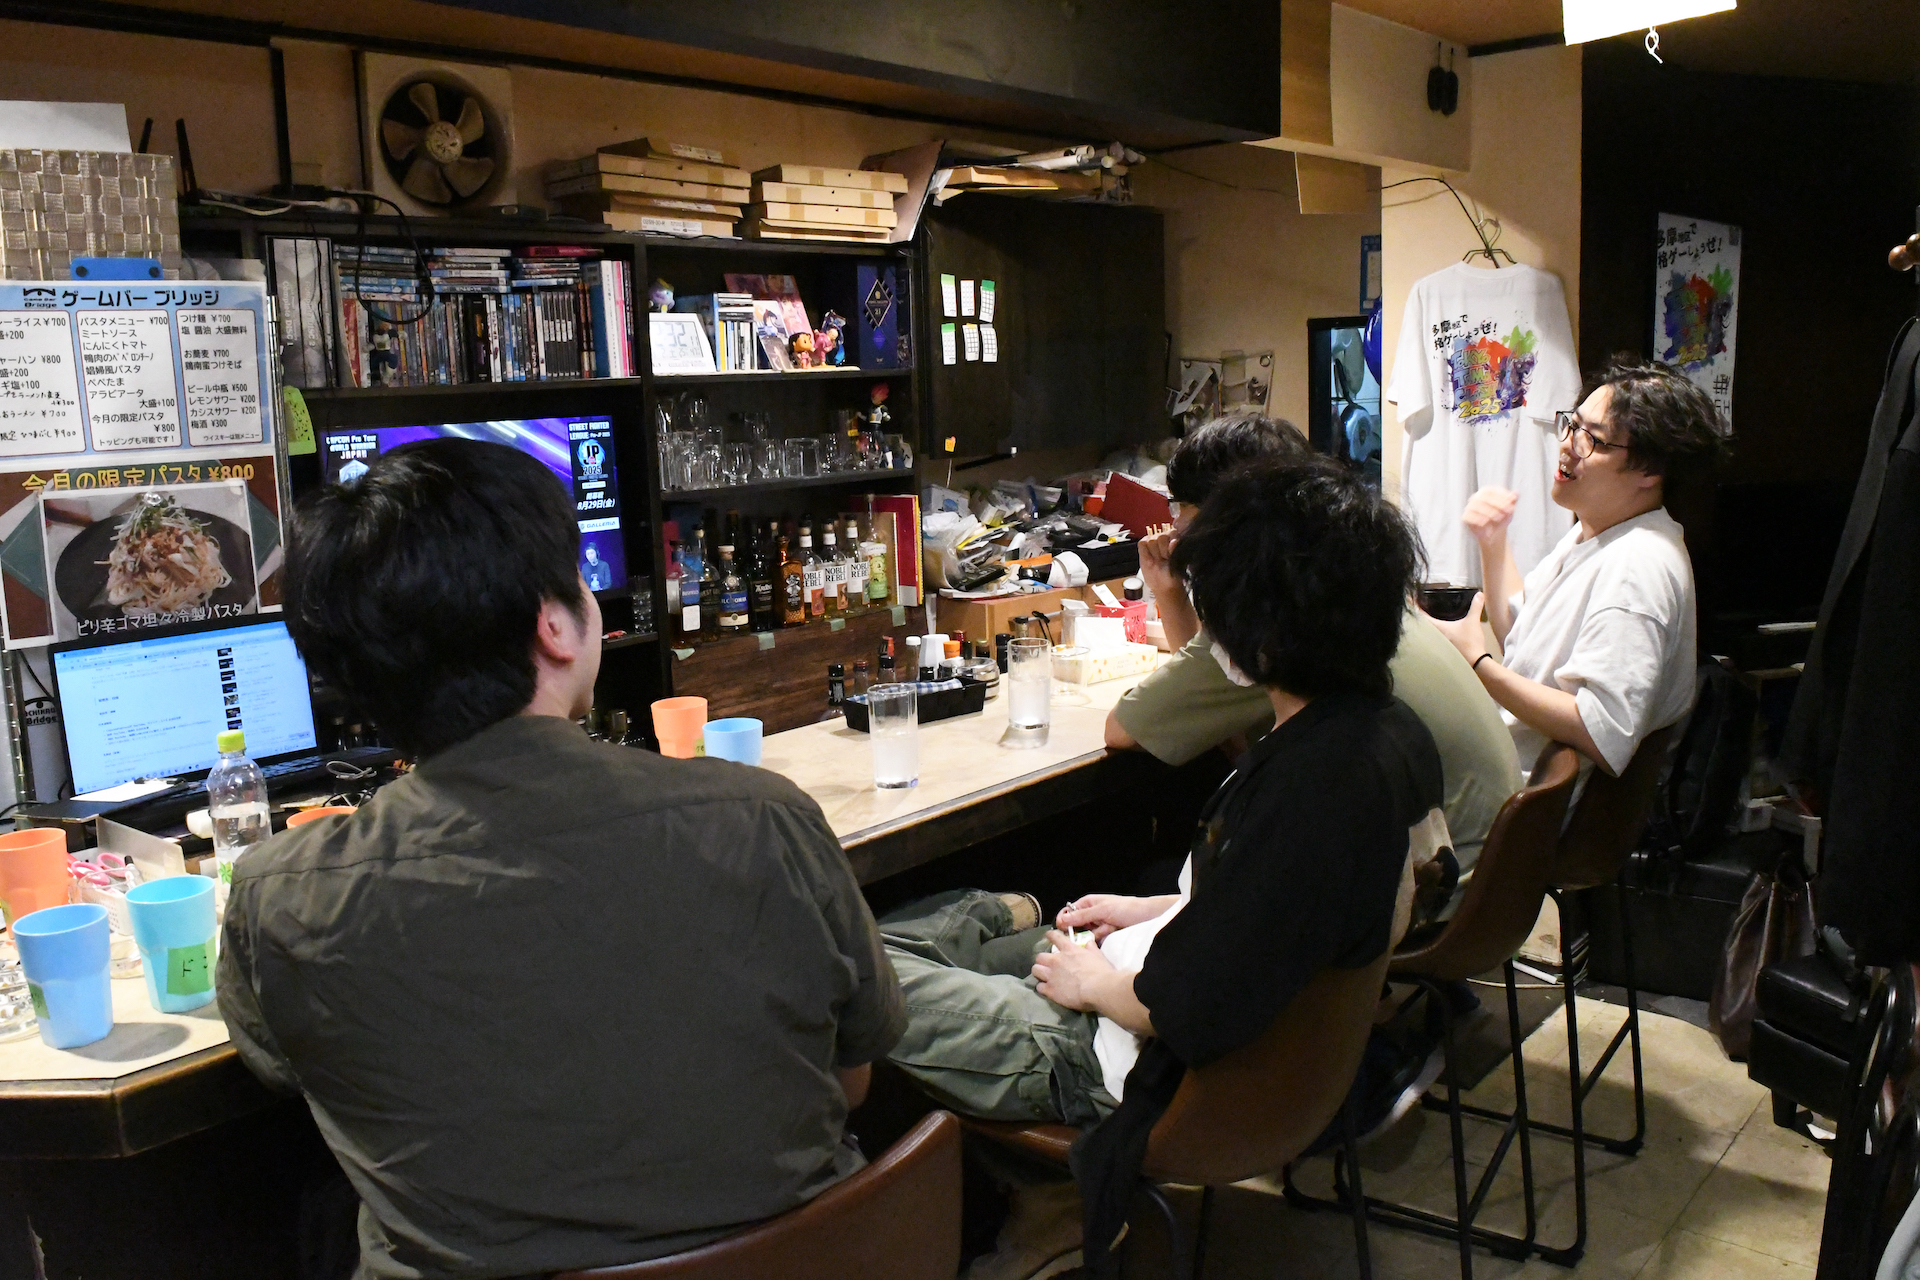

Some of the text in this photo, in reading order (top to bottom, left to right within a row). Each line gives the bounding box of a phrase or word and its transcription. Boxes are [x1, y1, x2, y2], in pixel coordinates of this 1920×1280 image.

[62, 289, 220, 307] ゲームバー ブリッジ
[0, 317, 66, 327] ーライス ¥700
[149, 316, 168, 326] ¥700
[210, 314, 231, 323] ¥700
[82, 328, 138, 338] ミートソース
[215, 326, 248, 335] 大盛無料
[82, 340, 148, 351] にんにくトマト
[213, 349, 230, 358] ¥700
[41, 355, 61, 364] ¥800
[188, 383, 248, 394] ビール中瓶 ¥500
[88, 388, 144, 400] アラビアータ
[138, 398, 175, 409] 大盛+100
[188, 394, 256, 406] レモンサワー ¥200
[190, 406, 257, 417] カシスサワー ¥200
[1458, 398, 1502, 418] 2025
[92, 412, 164, 424] 今月の限定パスタ
[154, 423, 175, 432] ¥800
[190, 419, 228, 429] 梅酒 ¥300
[568, 422, 588, 432] STREET
[570, 432, 589, 440] LEAGUE
[340, 450, 368, 460] JAPAN
[208, 463, 255, 482] ¥800
[583, 466, 602, 475] 2025
[577, 498, 616, 511] 8月29日(金)
[586, 520, 616, 528] GALLERIA
[804, 570, 822, 580] OBLE
[825, 565, 846, 575] NOBLE
[804, 578, 822, 588] EBEL
[825, 574, 846, 583] REBEL
